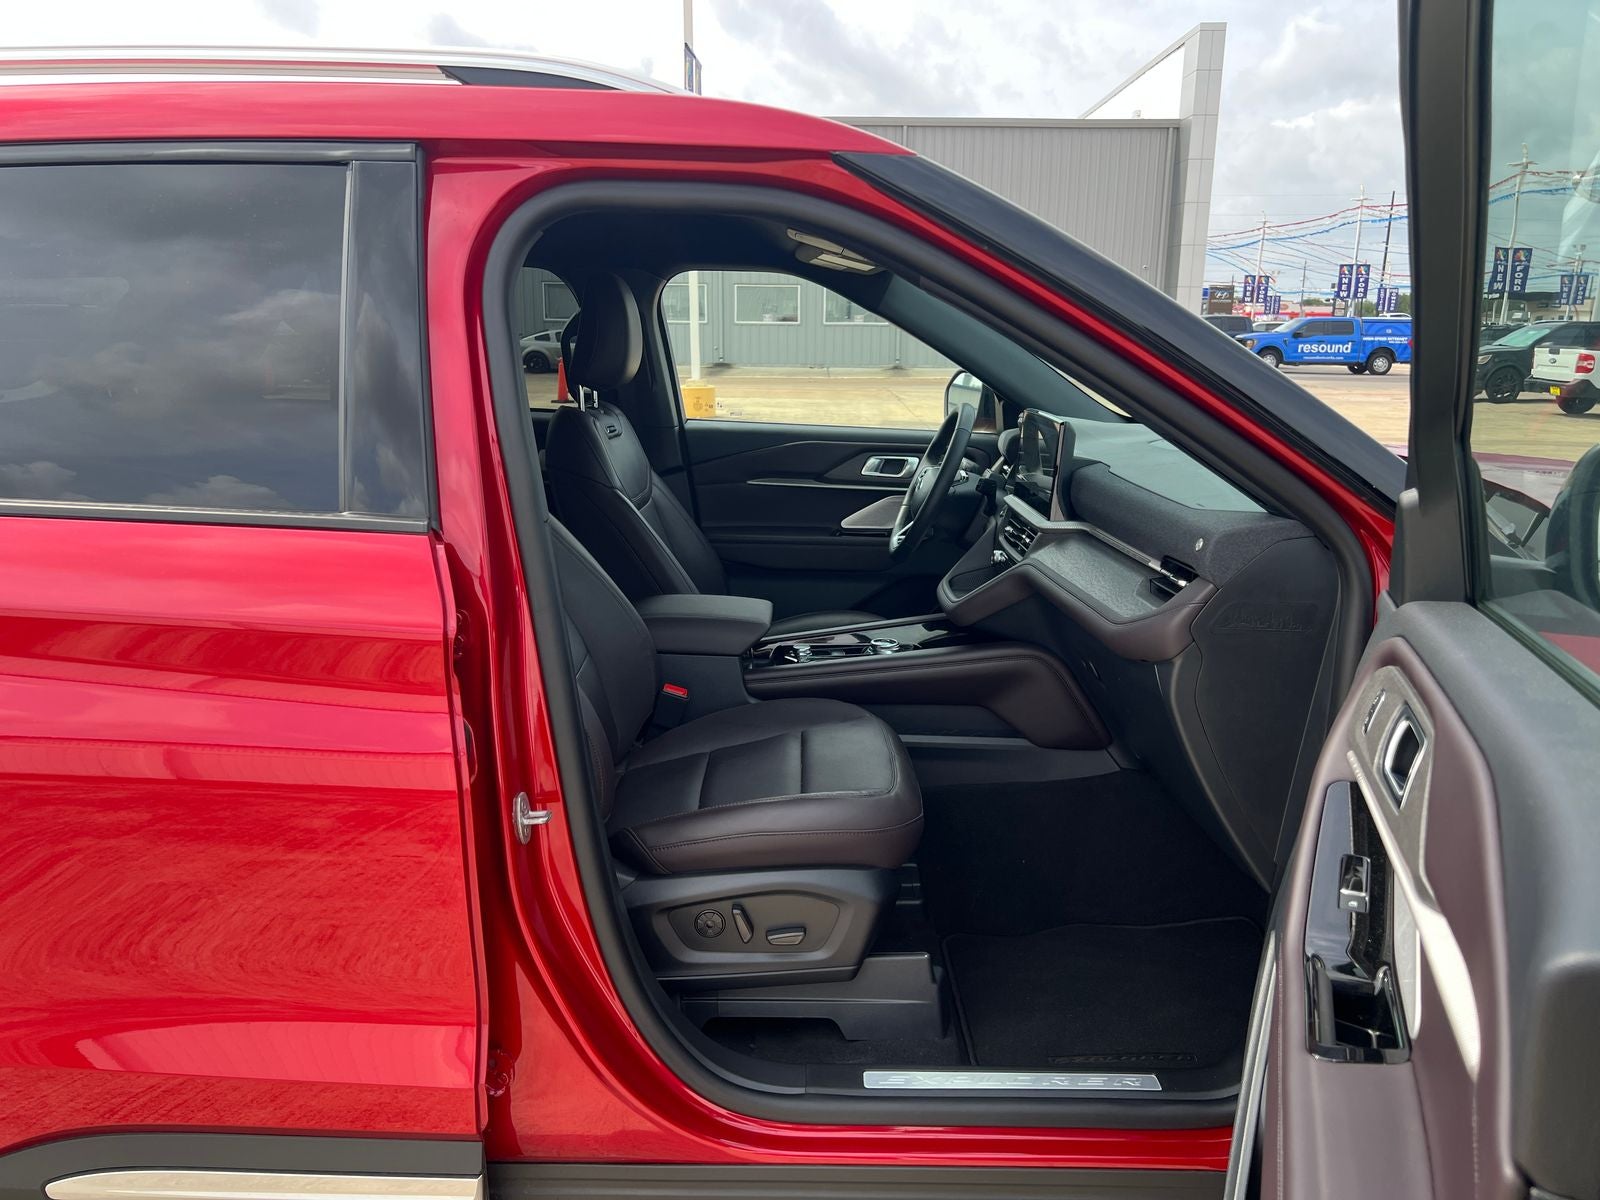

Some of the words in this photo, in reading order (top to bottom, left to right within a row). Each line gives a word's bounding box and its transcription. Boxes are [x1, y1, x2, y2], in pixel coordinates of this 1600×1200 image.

[1339, 277, 1349, 298] NEW
[1357, 277, 1365, 297] FORD
[1494, 265, 1504, 290] NEW
[1514, 266, 1524, 291] FORD
[1297, 342, 1352, 353] resound
